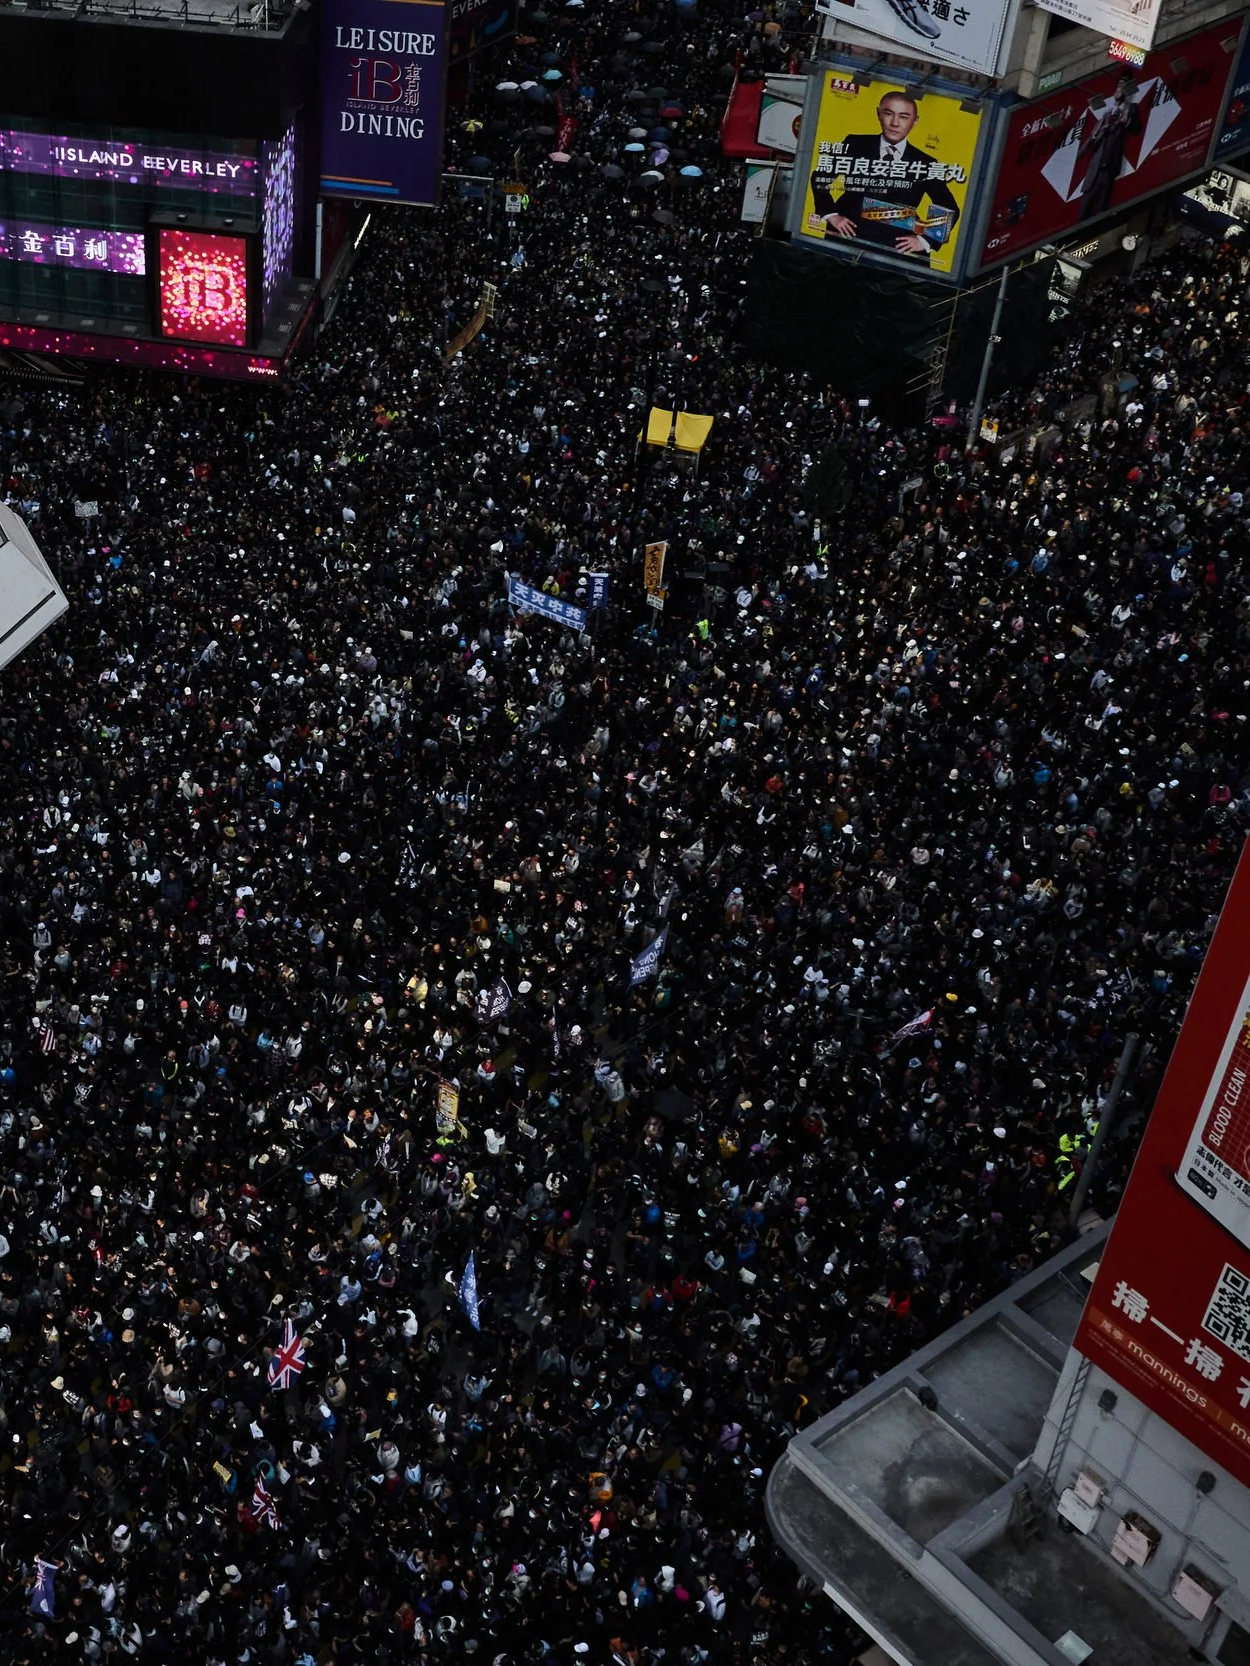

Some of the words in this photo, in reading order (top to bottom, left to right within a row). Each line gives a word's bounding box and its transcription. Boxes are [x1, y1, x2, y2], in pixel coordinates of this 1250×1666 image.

[335, 26, 436, 56] LEISURE
[340, 112, 425, 139] DINING
[816, 156, 966, 182] 馬百良安宮牛黃丸
[22, 229, 107, 262] 金百利
[1208, 1105, 1232, 1147] BLOOD
[1223, 1067, 1247, 1107] CLEAN
[1111, 1280, 1225, 1382] 掃一掃
[1127, 1340, 1207, 1408] mannings
